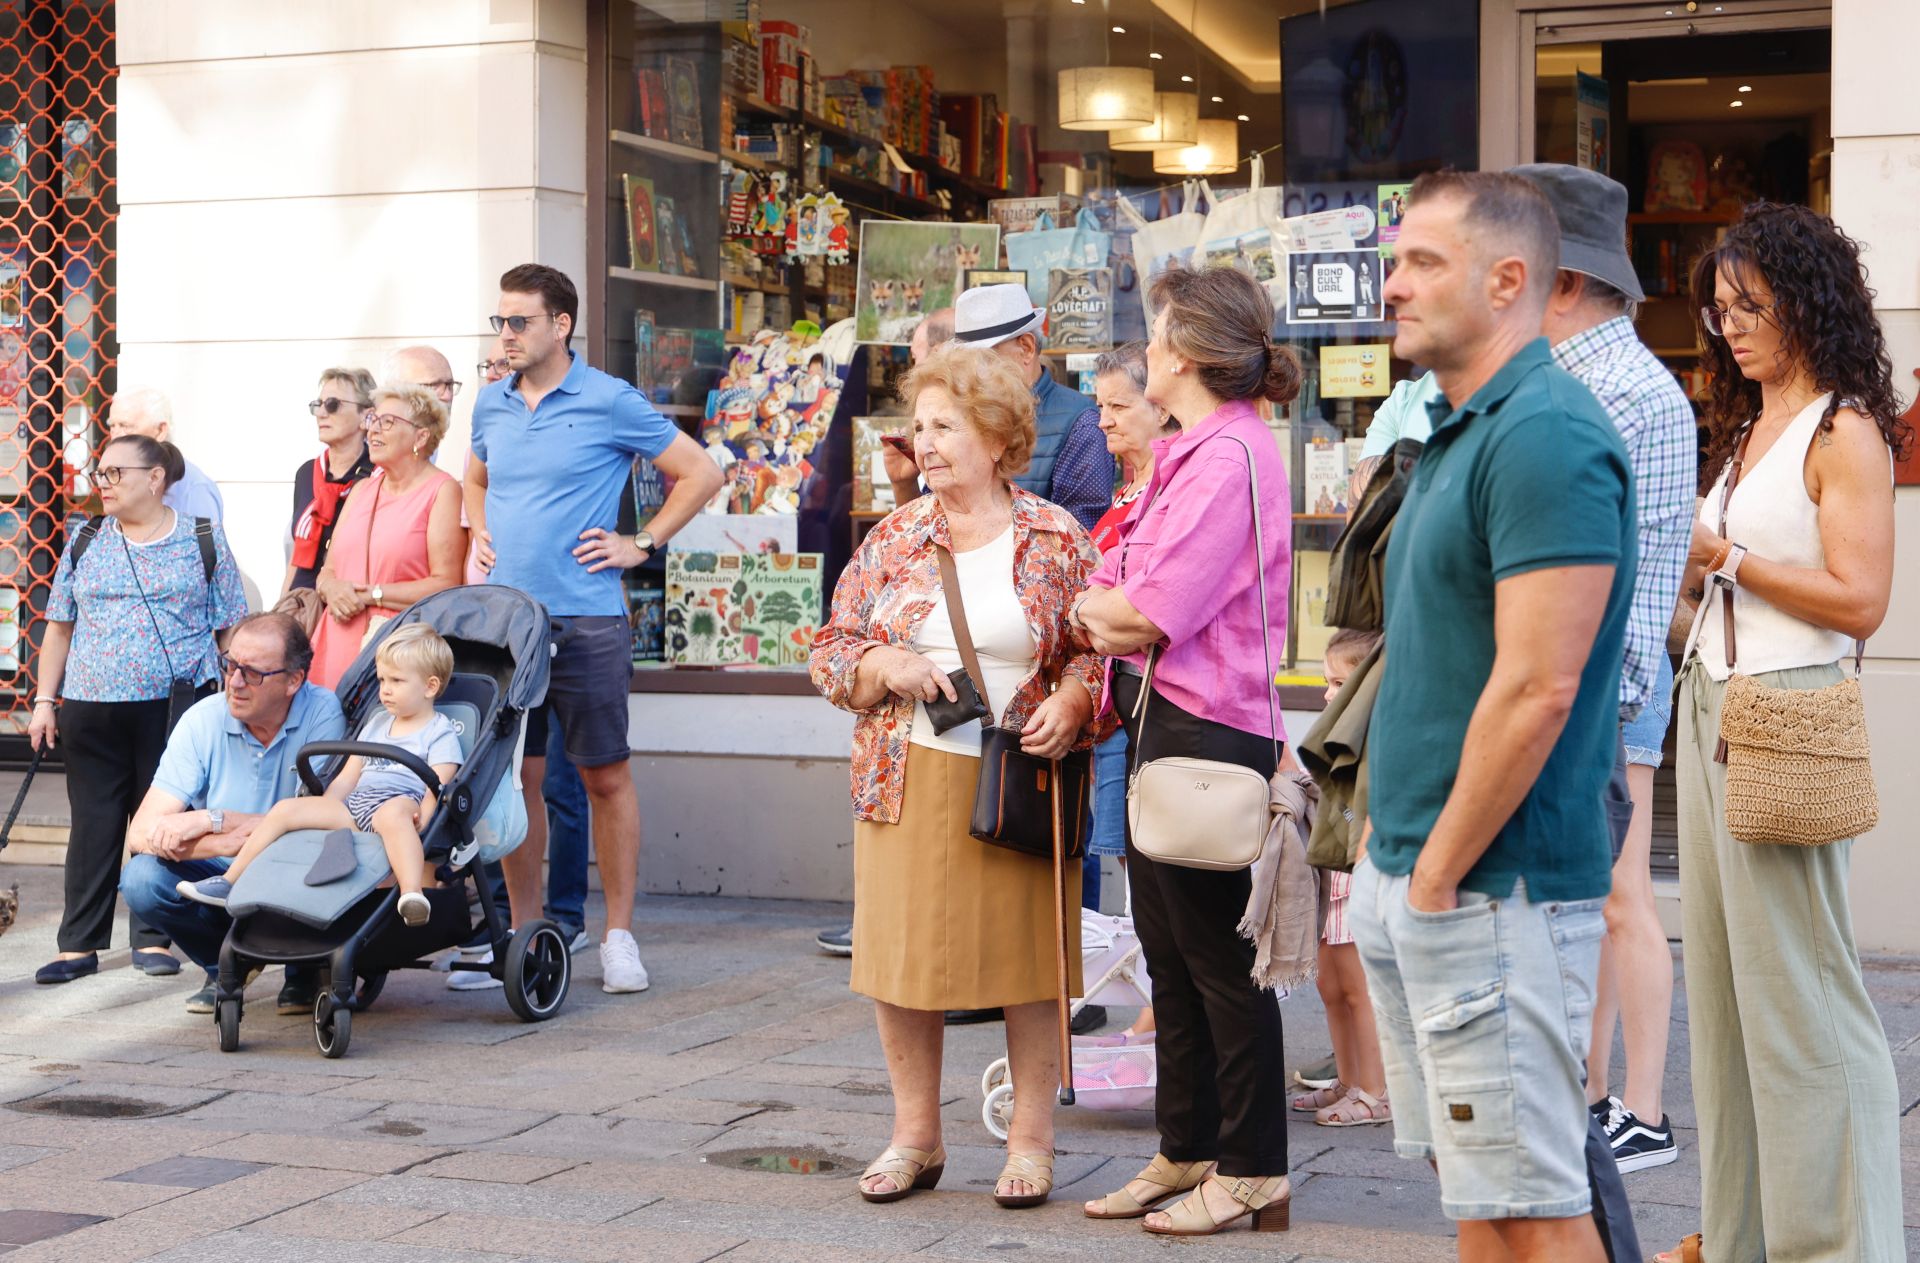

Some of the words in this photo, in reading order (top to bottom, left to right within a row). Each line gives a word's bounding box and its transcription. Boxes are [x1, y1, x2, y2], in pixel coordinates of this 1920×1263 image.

[1317, 268, 1343, 276] BONO
[1051, 301, 1106, 313] LOVECRAFT
[1311, 472, 1338, 480] CASTILLA
[639, 482, 664, 506] BANG
[674, 573, 733, 583] Botanicum
[750, 573, 811, 584] Arboretum
